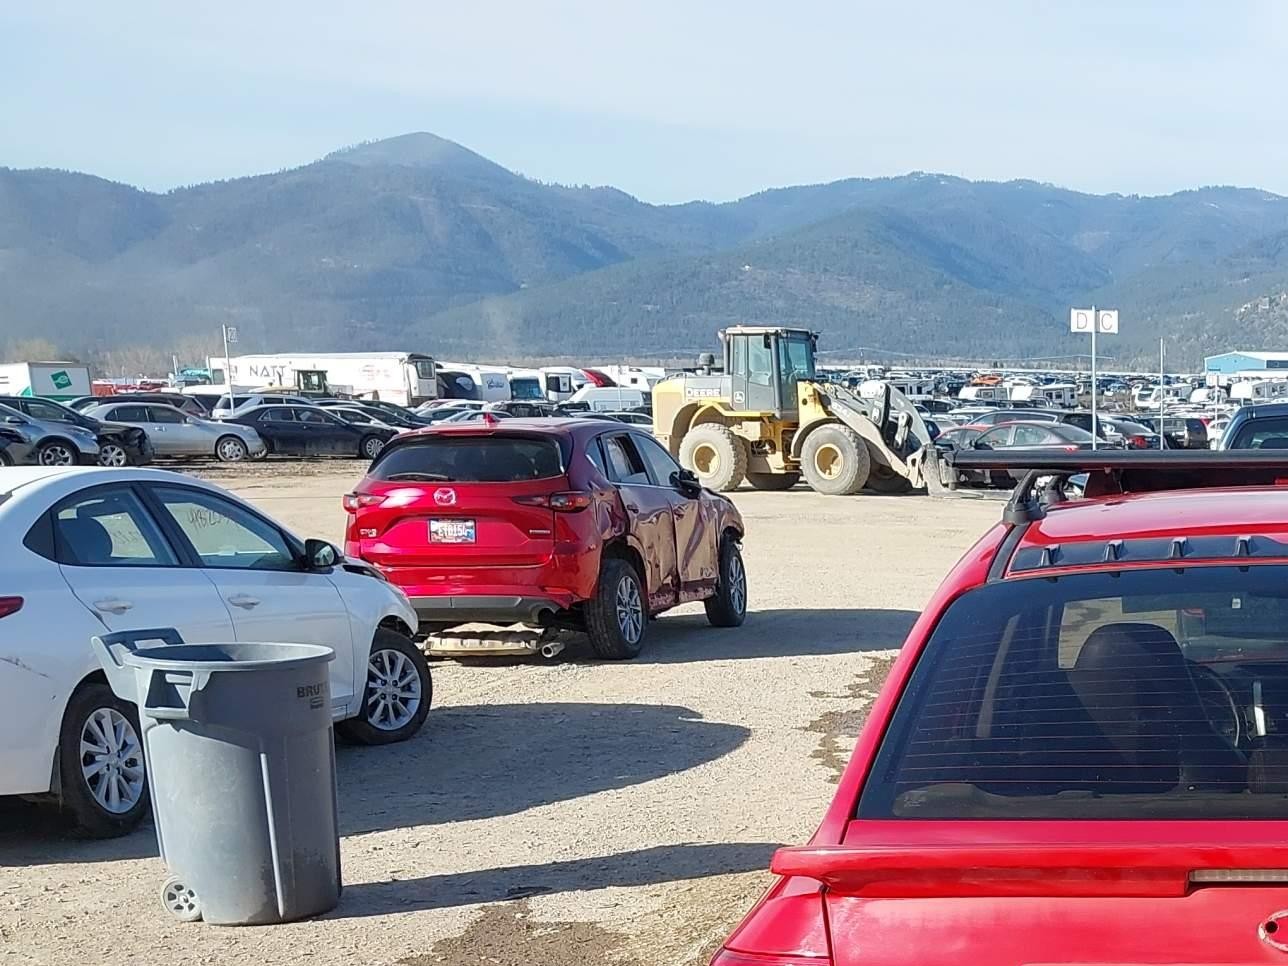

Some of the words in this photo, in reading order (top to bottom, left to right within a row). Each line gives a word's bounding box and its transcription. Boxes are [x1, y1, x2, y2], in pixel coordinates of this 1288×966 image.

[1076, 312, 1088, 330] D
[1101, 313, 1113, 331] C
[687, 387, 721, 397] DEERE
